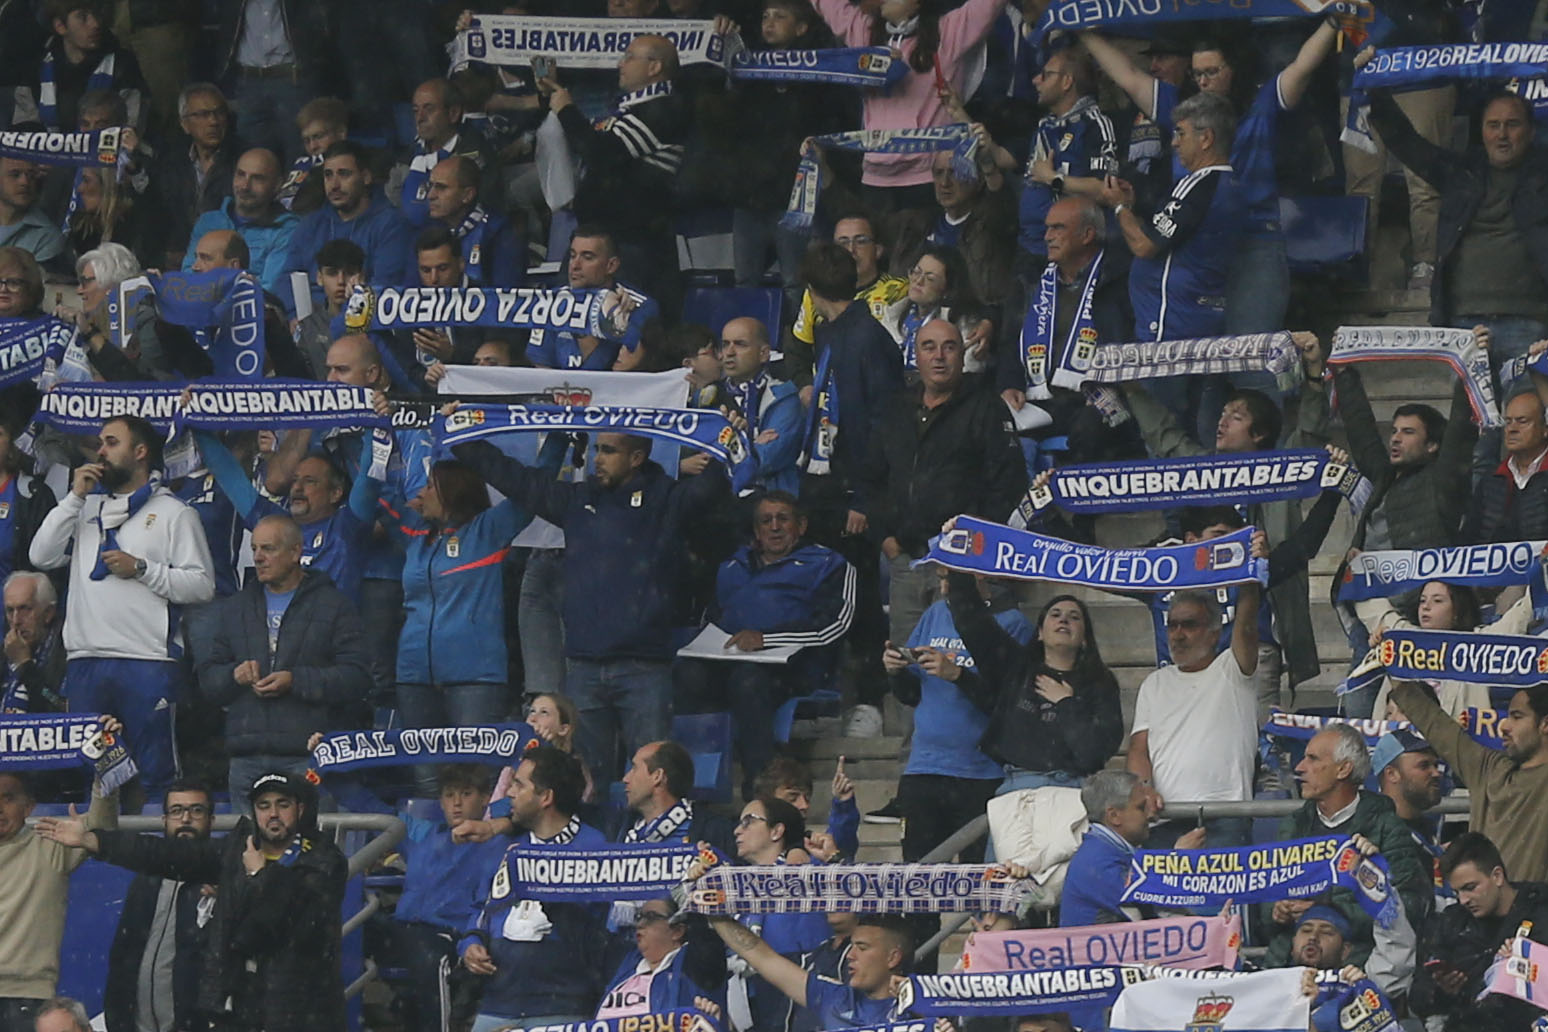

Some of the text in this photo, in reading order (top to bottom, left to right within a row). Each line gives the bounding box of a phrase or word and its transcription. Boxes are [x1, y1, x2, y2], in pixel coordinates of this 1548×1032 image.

[378, 289, 588, 327] FORZA OVIEDO
[508, 403, 573, 425] Real
[1057, 461, 1315, 498] INQUEBRANTABLES
[1056, 549, 1178, 586] OVIEDO
[1365, 542, 1533, 587] Real OVIEDO
[1399, 641, 1537, 675] Real OVIEDO
[315, 725, 518, 767] REAL OVIEDO
[517, 855, 692, 886] INQUEBRANTABLES
[1142, 838, 1336, 874] PEÑA AZUL OLIVARES
[737, 869, 974, 899] Real Oviedo
[1163, 866, 1304, 893] MI CORAZON ES AZUL
[1004, 920, 1208, 970] Real OVIEDO
[916, 966, 1116, 999] INQUEBRANTABLES
